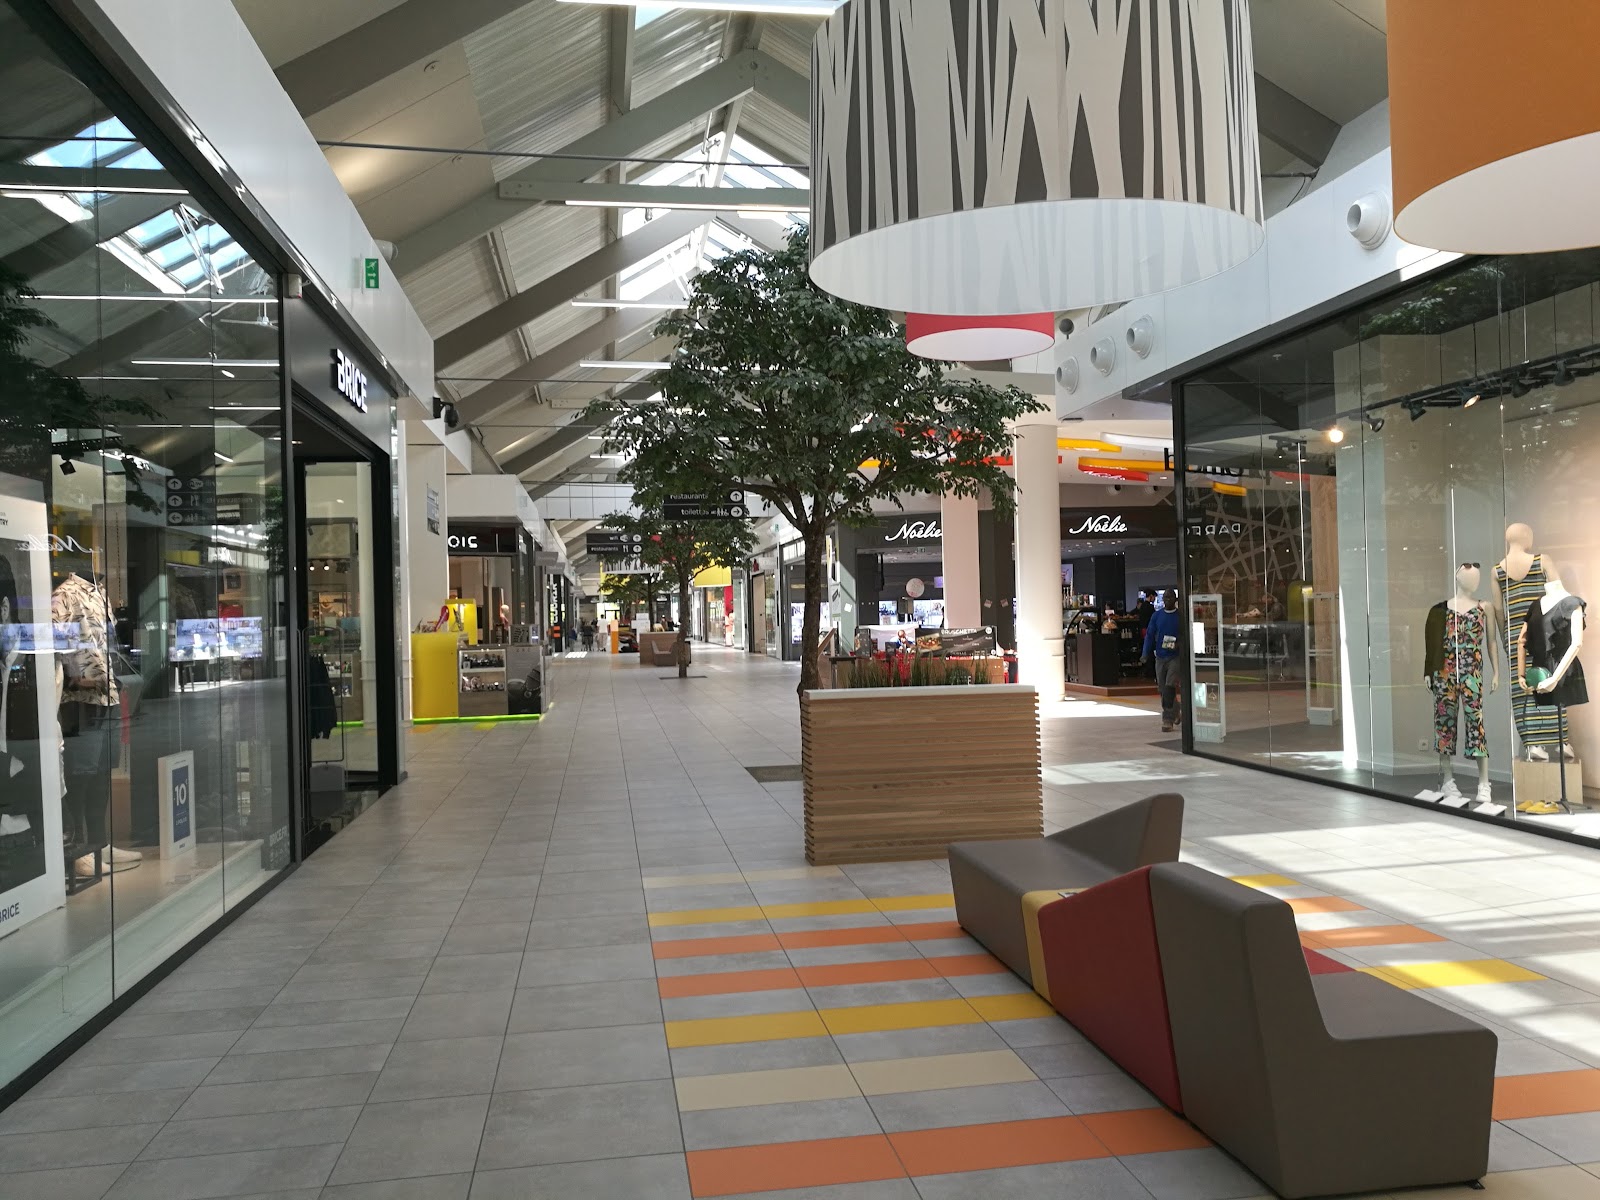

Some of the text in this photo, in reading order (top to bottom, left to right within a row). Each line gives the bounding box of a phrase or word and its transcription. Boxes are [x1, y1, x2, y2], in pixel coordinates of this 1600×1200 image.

[337, 349, 368, 413] BRICE
[885, 520, 943, 541] Noélie
[1069, 515, 1128, 534] Noélie
